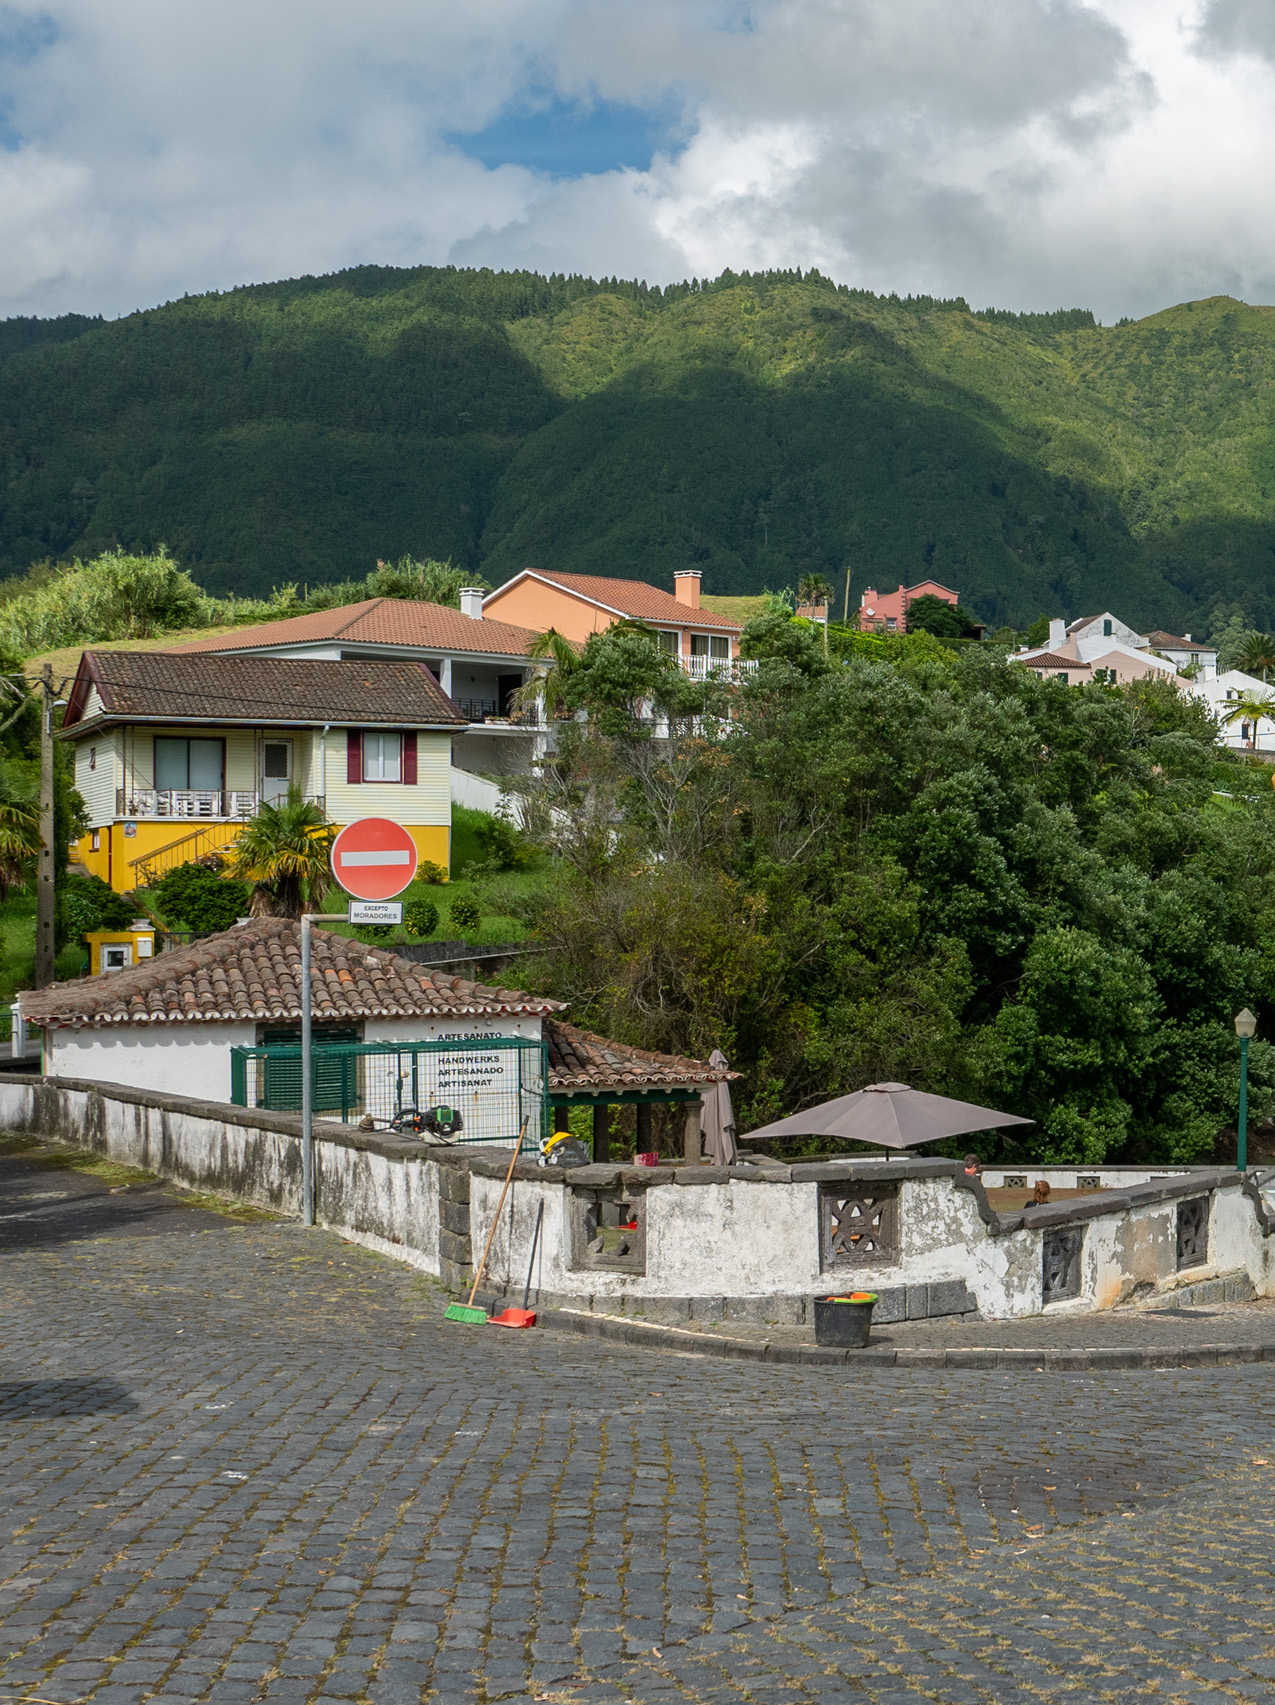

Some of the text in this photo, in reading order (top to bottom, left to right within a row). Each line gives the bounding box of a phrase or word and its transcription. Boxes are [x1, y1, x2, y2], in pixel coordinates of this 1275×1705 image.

[438, 1032, 502, 1041] ARTESANATO
[438, 1055, 500, 1065] HANDWERKS
[438, 1067, 504, 1076] ARTESANADO
[438, 1079, 492, 1088] ARTISANAT
